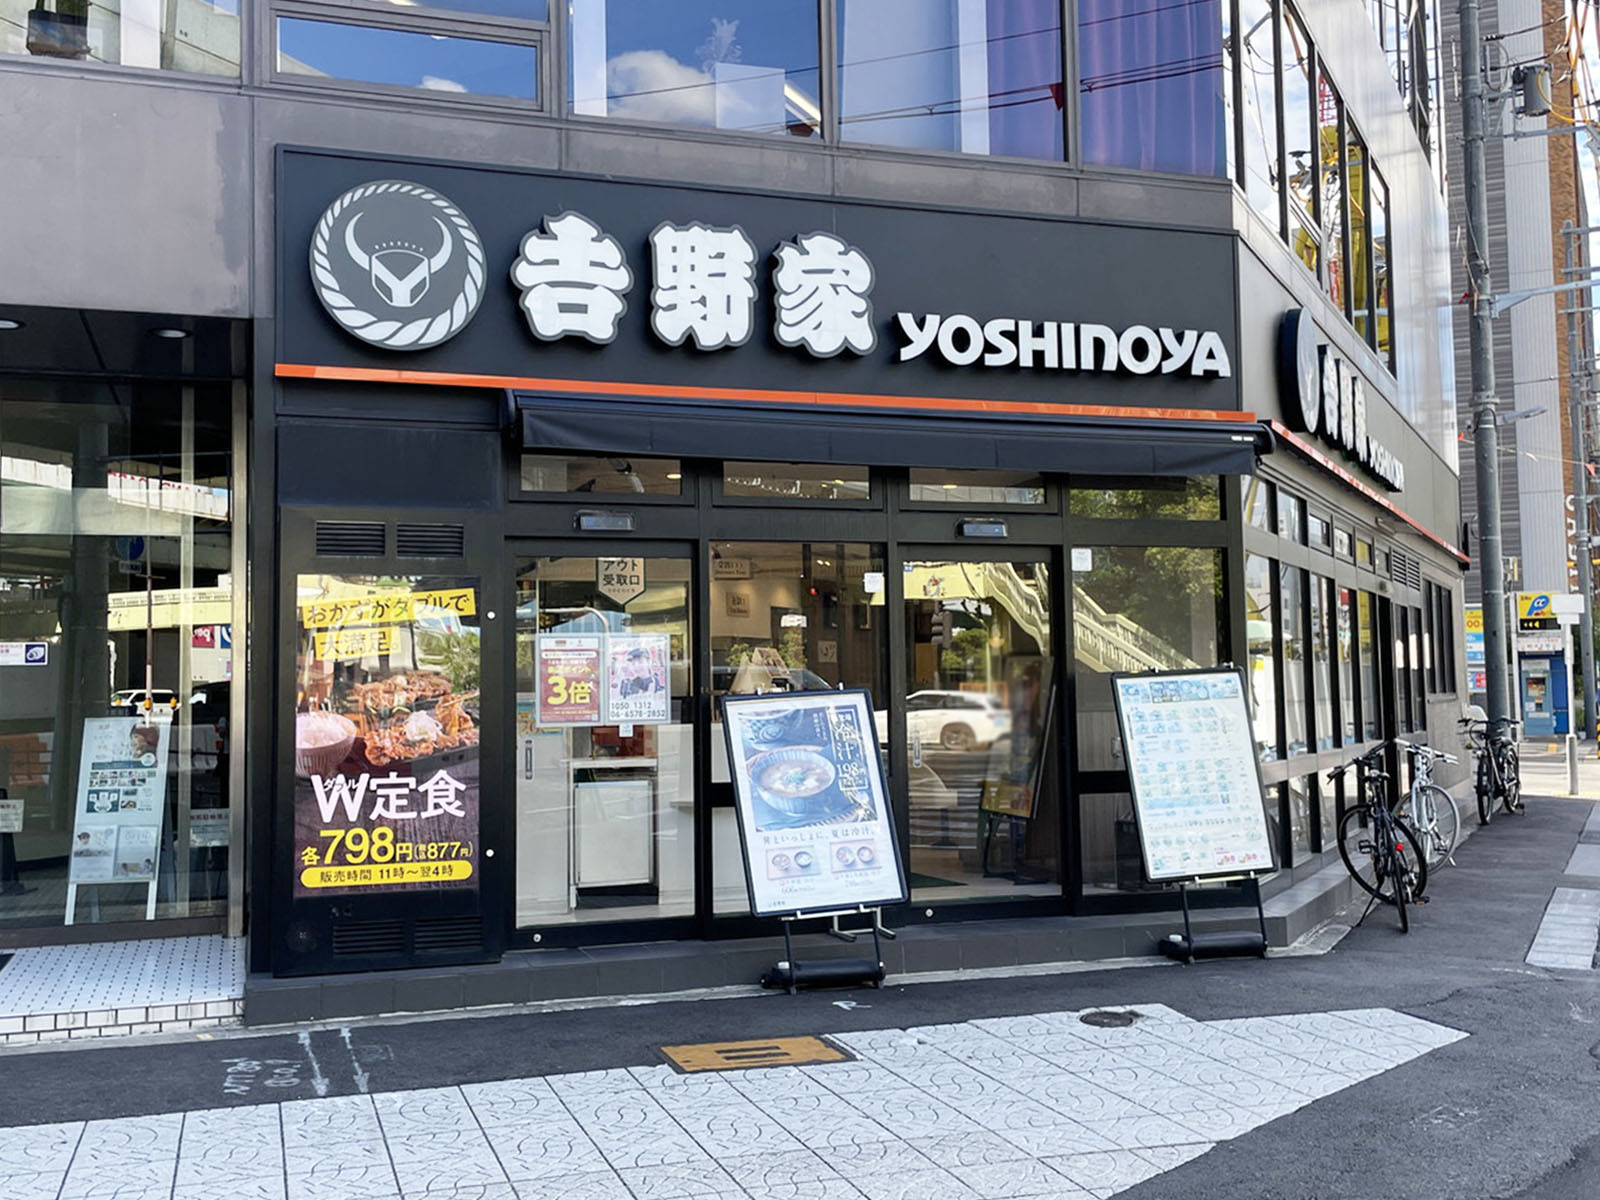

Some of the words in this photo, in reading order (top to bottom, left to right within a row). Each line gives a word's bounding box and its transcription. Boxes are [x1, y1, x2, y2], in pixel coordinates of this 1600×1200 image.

[897, 312, 1231, 378] YOSHINOYA
[603, 559, 638, 572] アウト
[603, 573, 640, 586] 受取口
[307, 592, 470, 624] おかずがダブルで
[547, 675, 592, 705] 3倍
[310, 769, 467, 823] W定食
[319, 868, 372, 884] 販売時間
